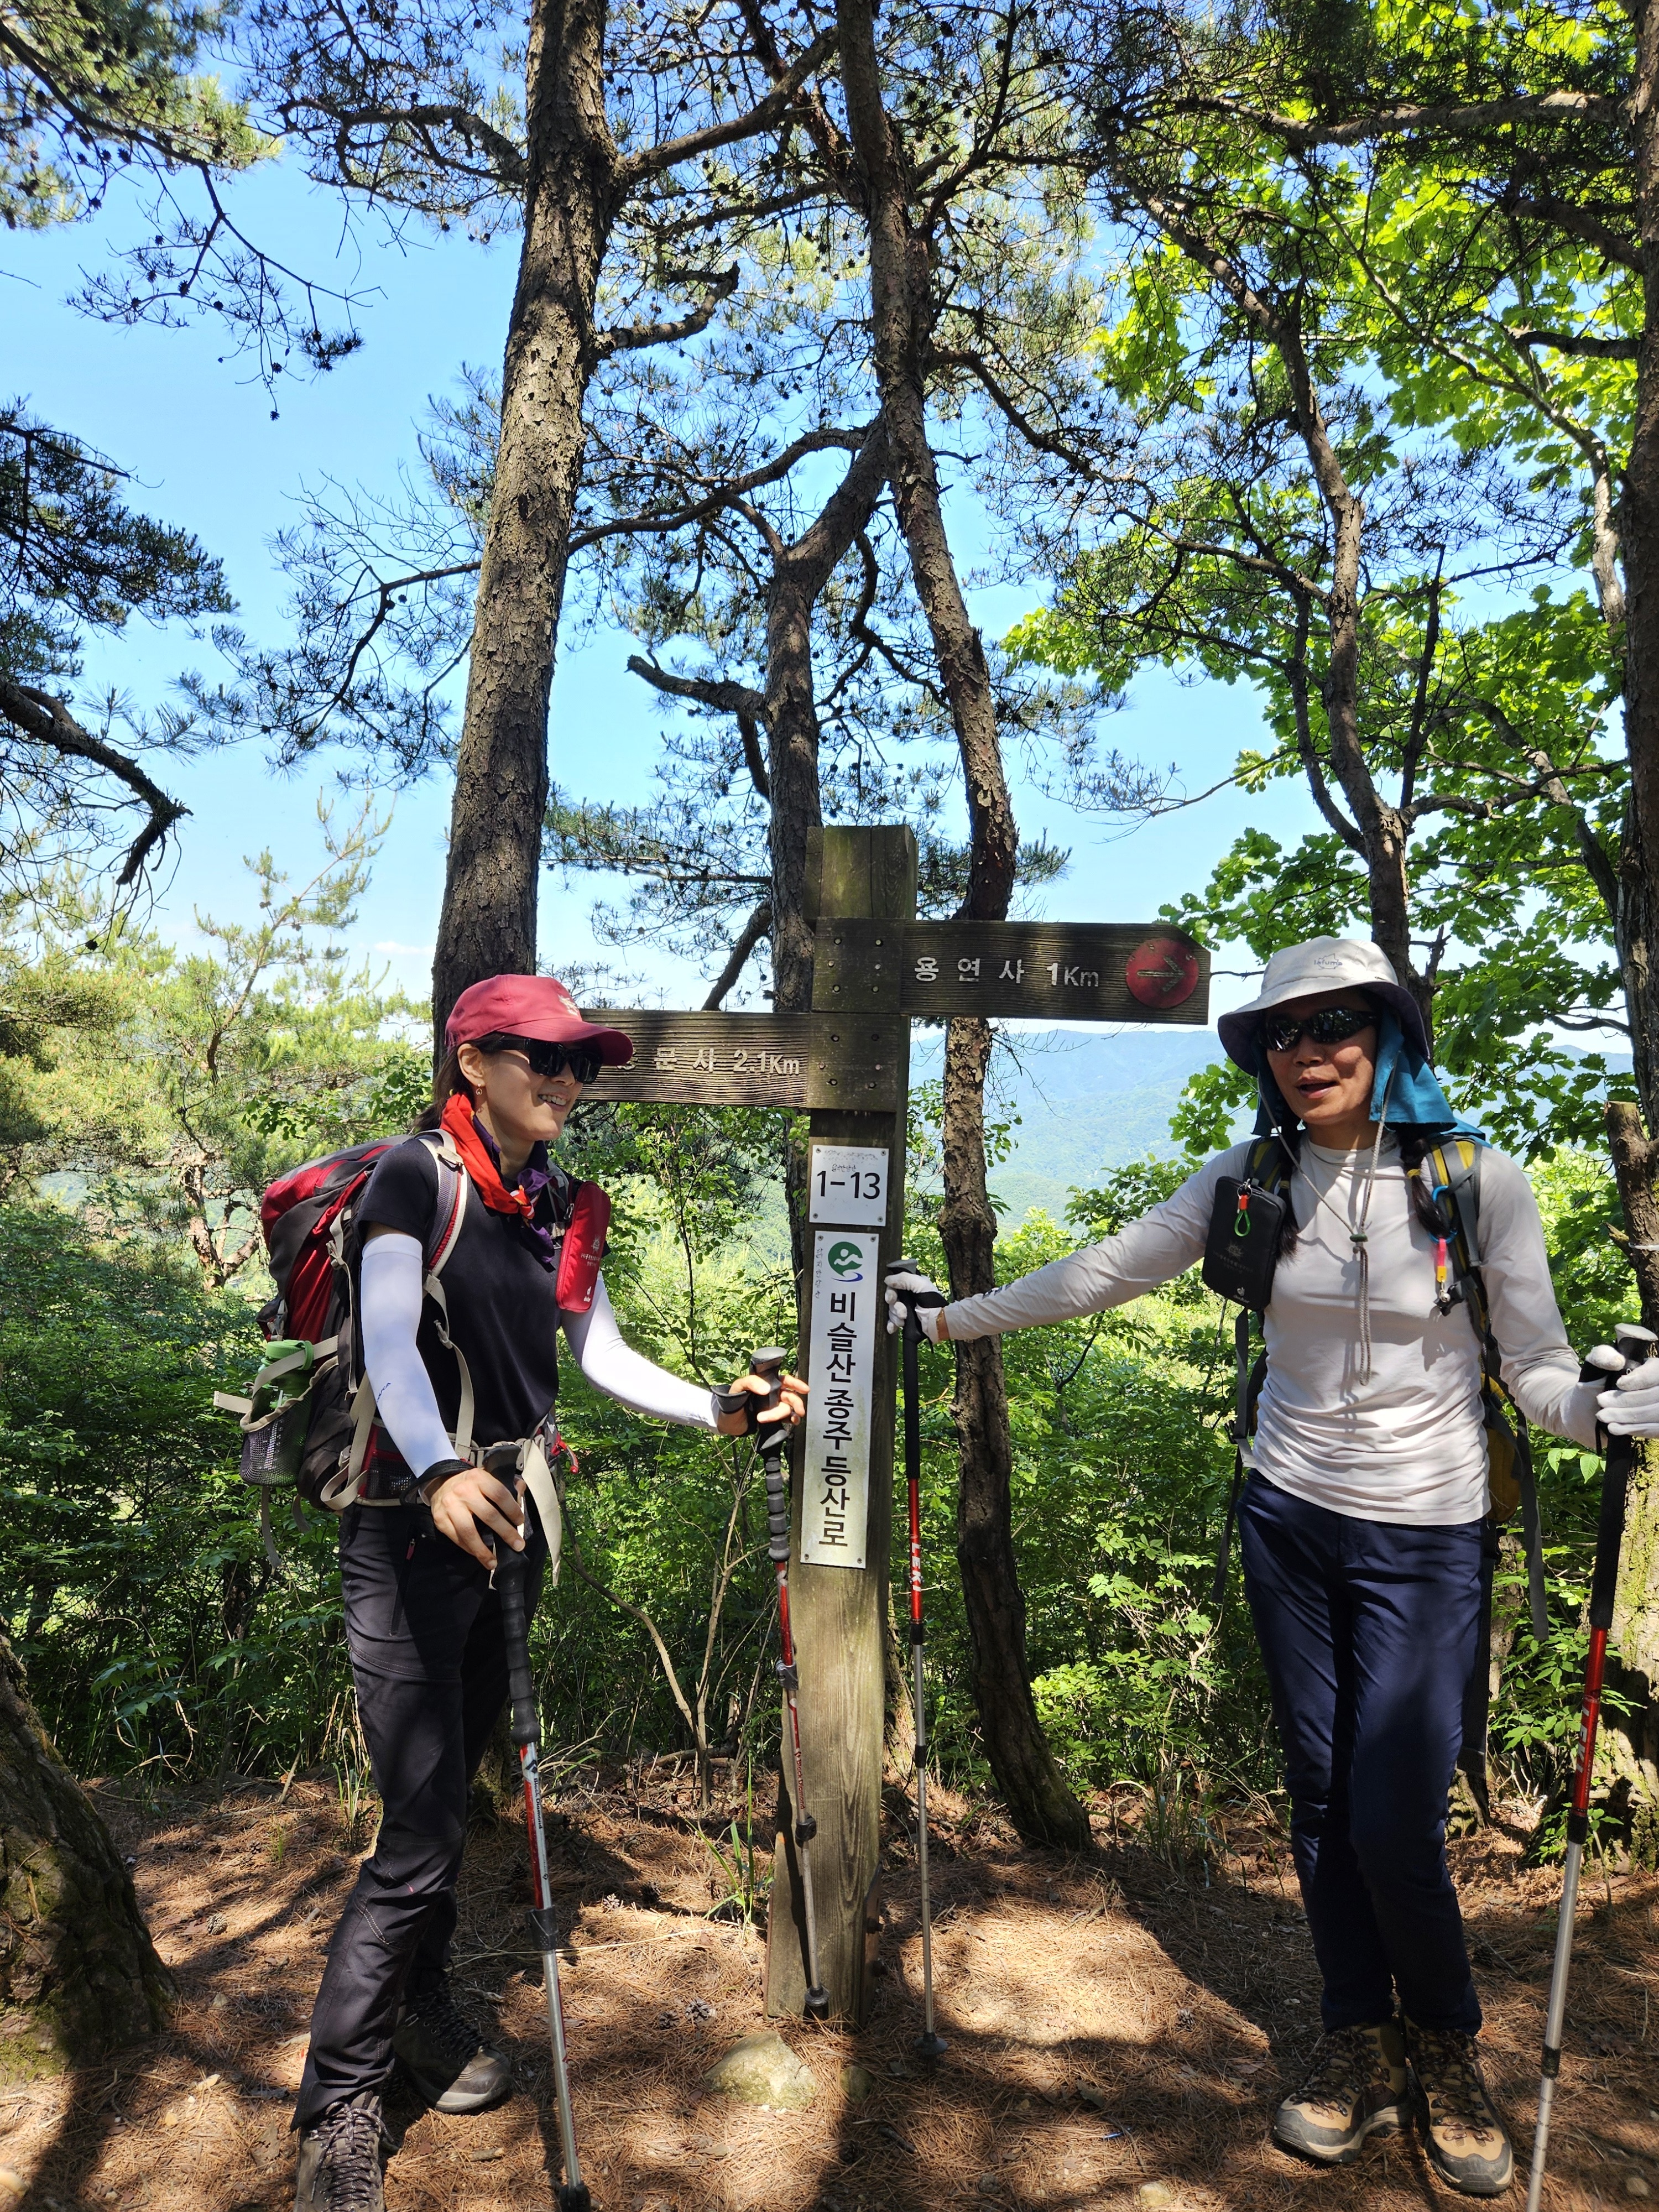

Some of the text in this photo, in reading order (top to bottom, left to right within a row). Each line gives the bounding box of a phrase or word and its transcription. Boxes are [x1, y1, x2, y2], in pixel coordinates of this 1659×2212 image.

[914, 957, 1099, 987] 용연사 1Km
[617, 1047, 800, 1076] 문사 2.1Km
[817, 1170, 880, 1199] 1-13
